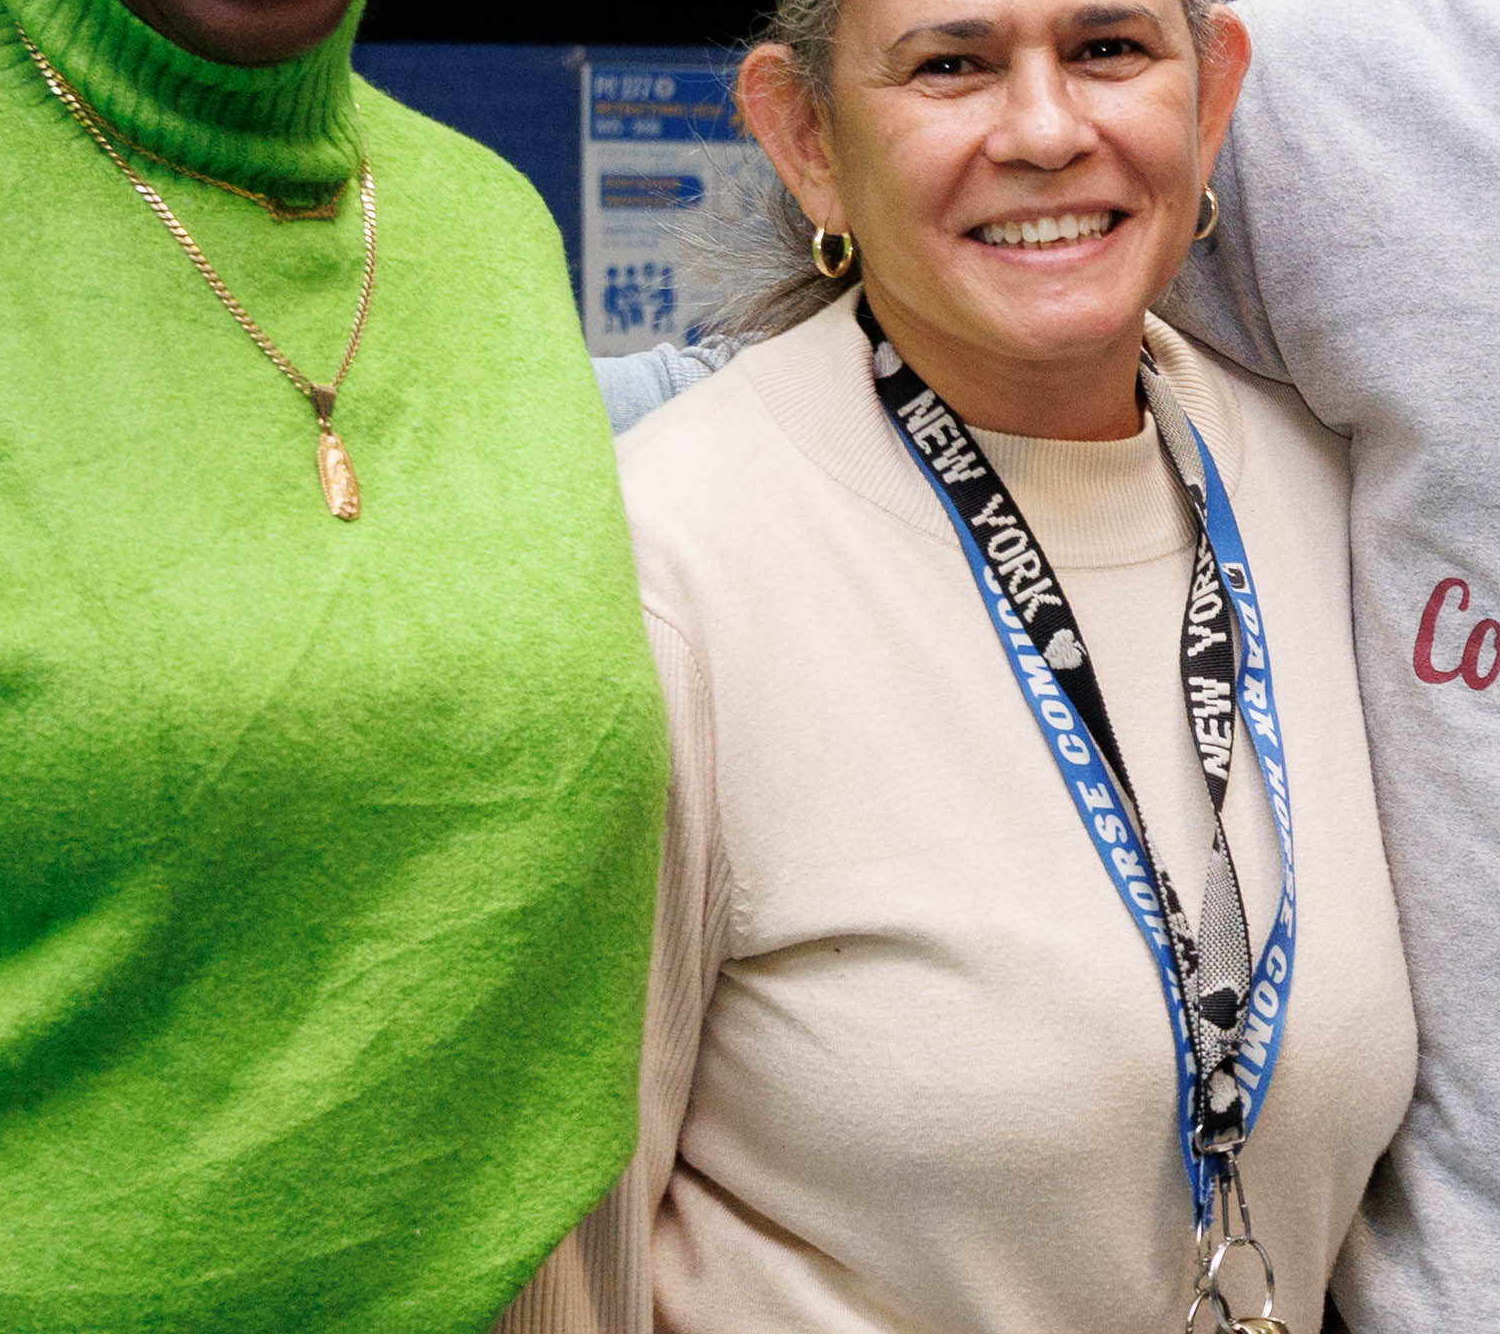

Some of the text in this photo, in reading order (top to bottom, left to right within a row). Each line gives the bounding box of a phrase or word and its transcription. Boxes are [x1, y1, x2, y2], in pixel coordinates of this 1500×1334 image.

[897, 389, 1062, 624] NEW YORK
[1187, 531, 1232, 779] NEW YORK
[1238, 602, 1279, 750] DARK
[1076, 780, 1168, 950] HORSE
